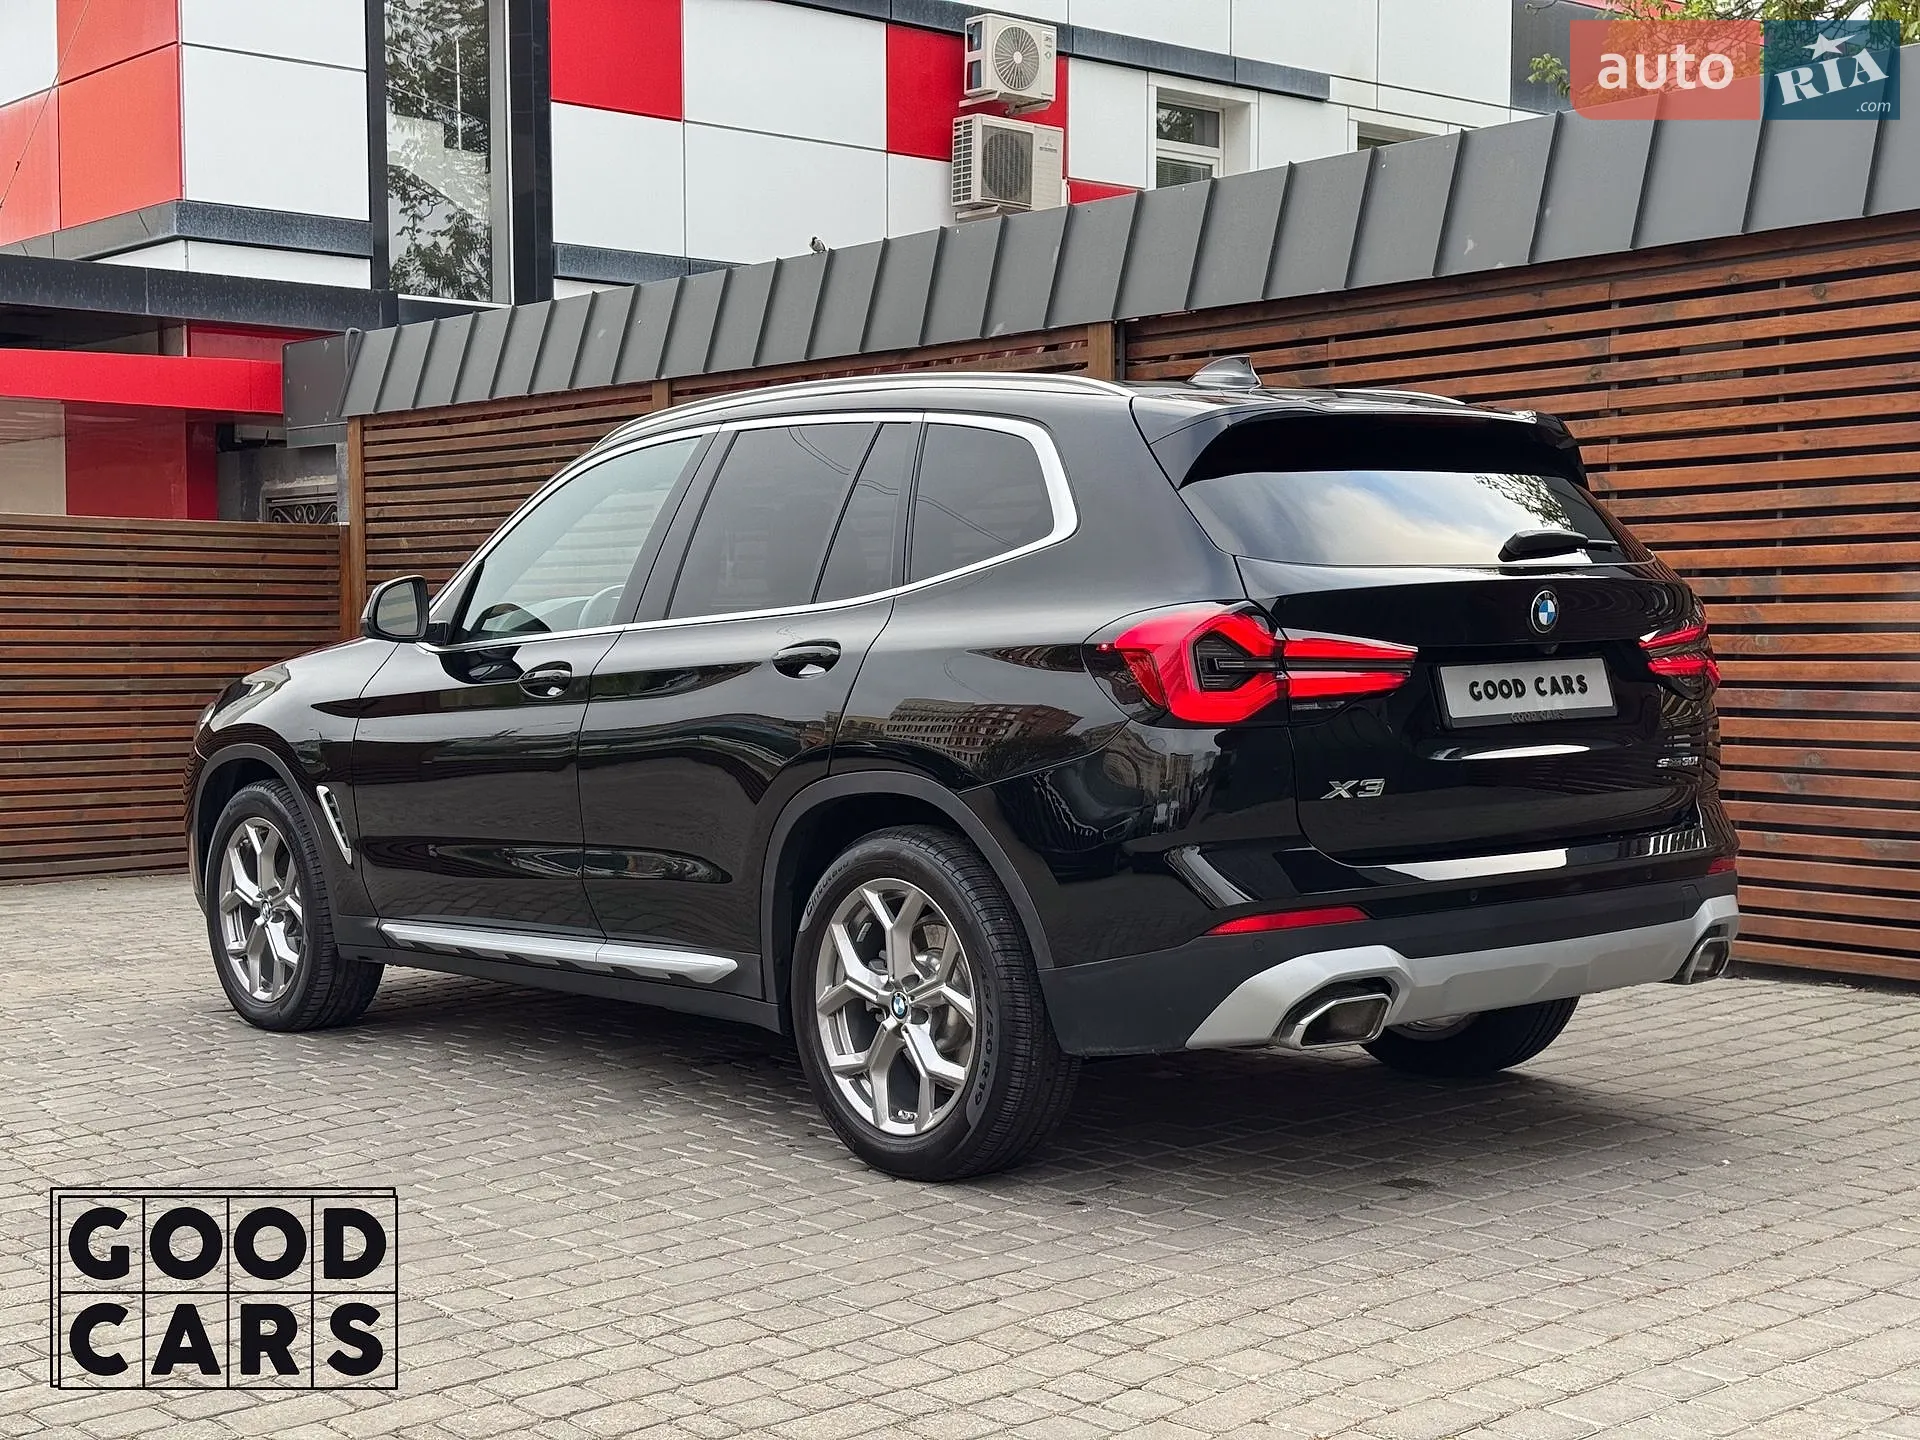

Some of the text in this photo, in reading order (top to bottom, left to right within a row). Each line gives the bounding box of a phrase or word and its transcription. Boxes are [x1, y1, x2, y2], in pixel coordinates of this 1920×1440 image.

[1469, 674, 1589, 702] GOOD CARS
[1320, 778, 1385, 800] X3
